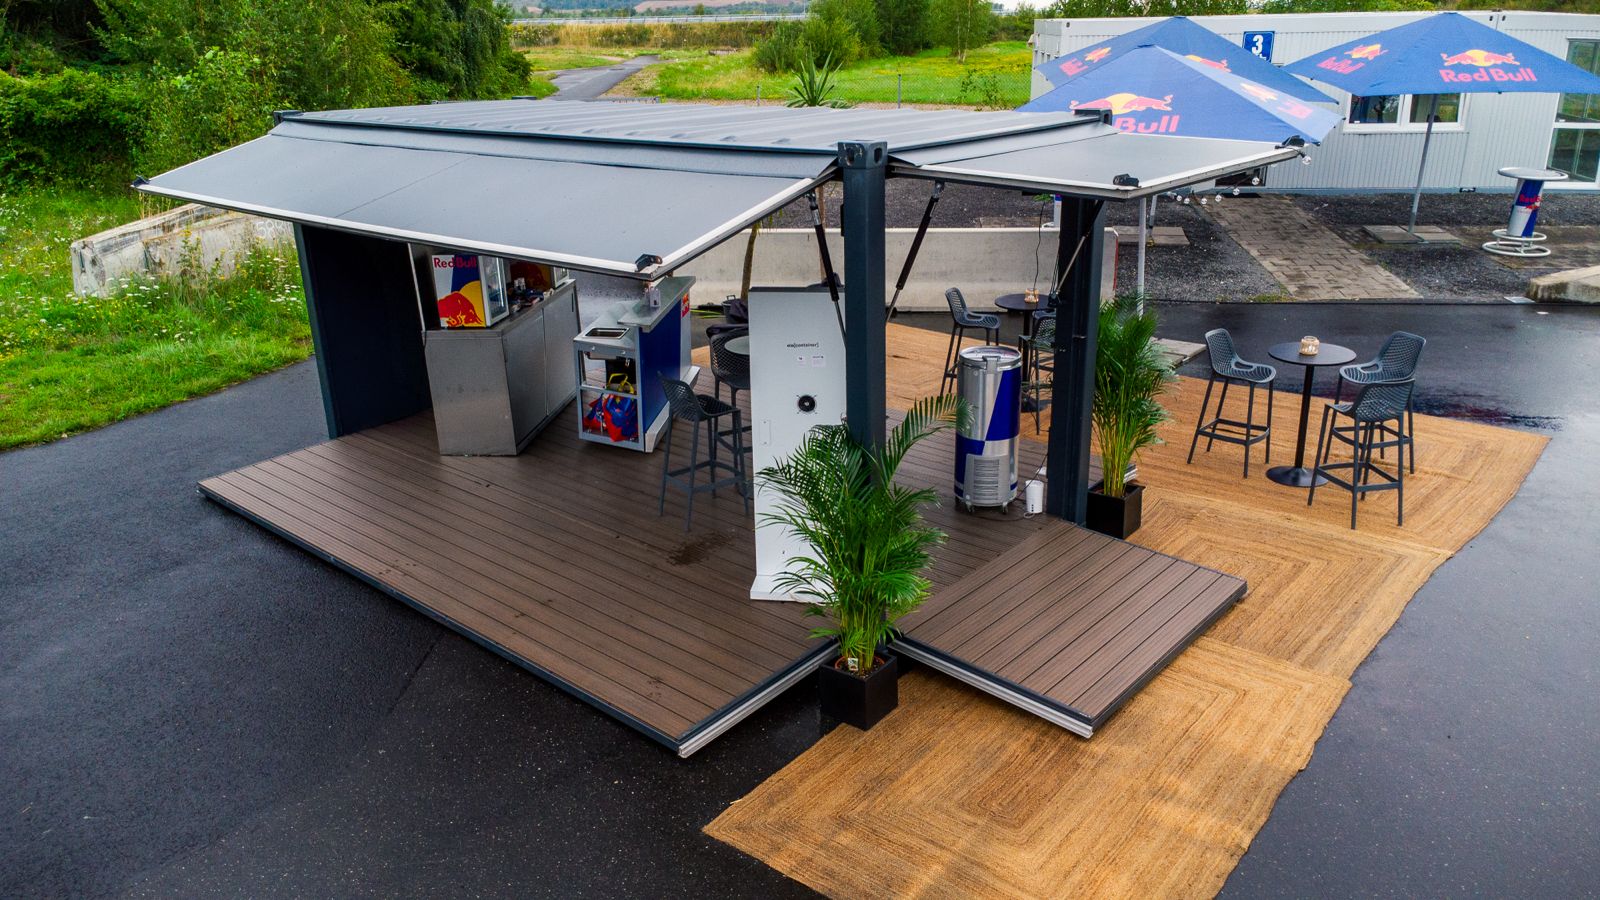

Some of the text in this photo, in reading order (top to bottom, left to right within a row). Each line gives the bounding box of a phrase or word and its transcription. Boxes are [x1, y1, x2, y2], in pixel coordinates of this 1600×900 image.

[1252, 34, 1264, 56] 3
[1439, 67, 1537, 82] Red Bull
[1113, 115, 1180, 133] Bull
[434, 255, 478, 269] Red Bull
